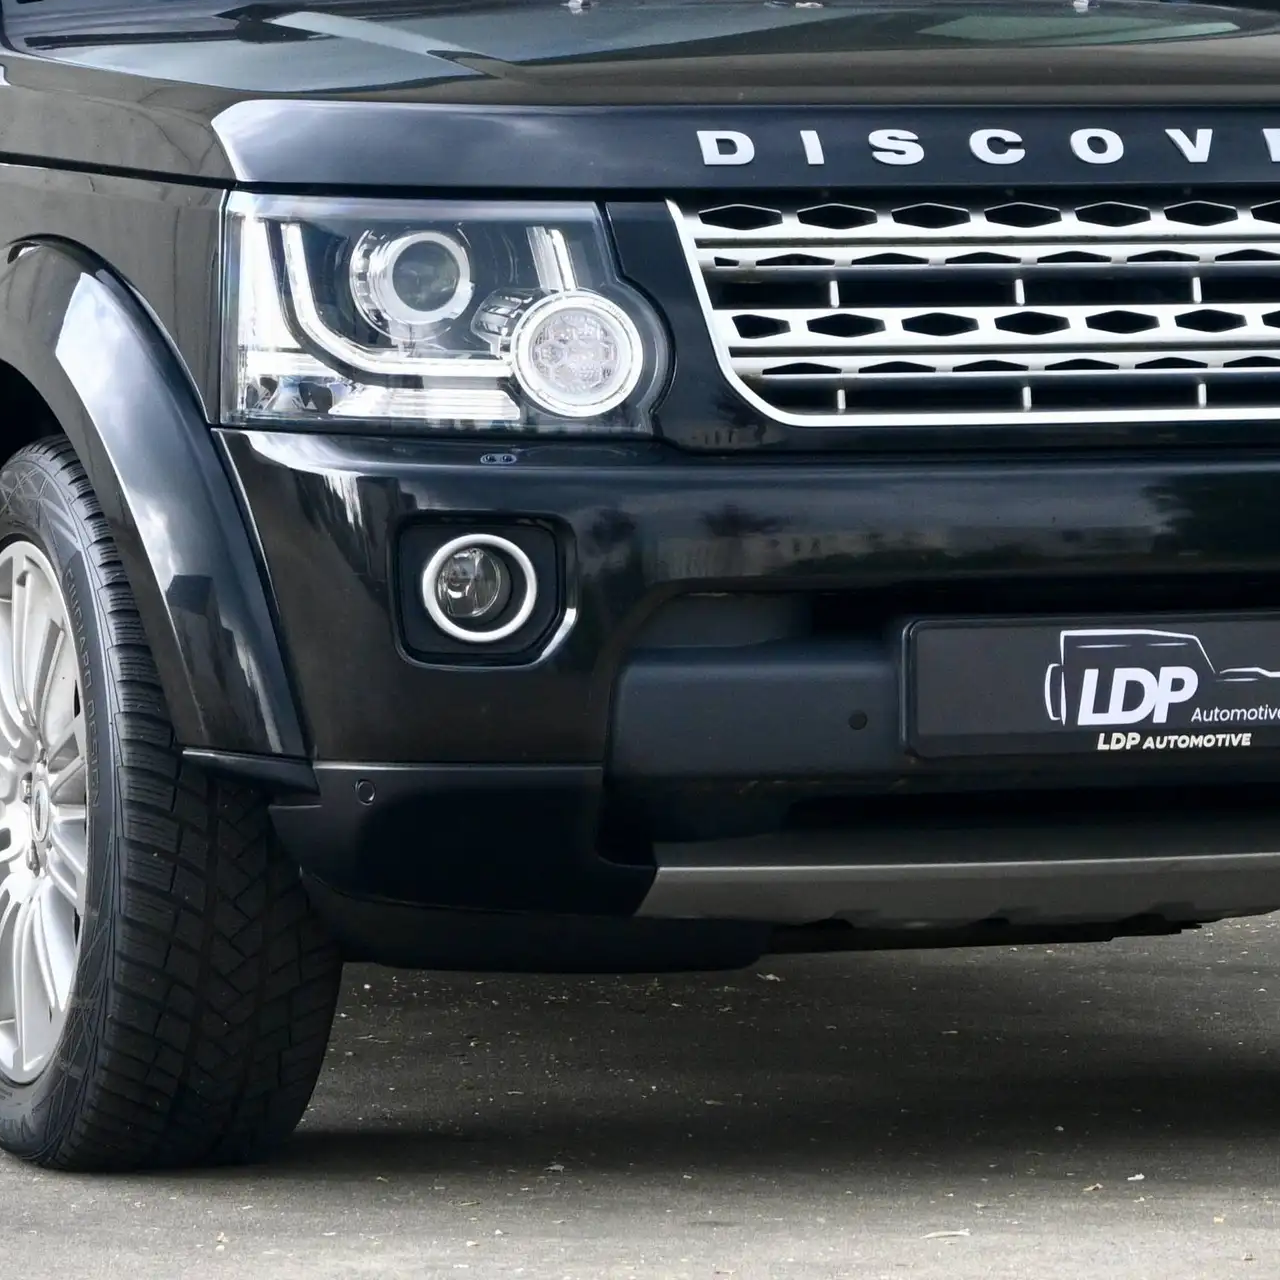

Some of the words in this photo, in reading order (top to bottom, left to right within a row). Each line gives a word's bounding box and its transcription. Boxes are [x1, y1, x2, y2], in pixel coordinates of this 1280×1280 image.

[1077, 666, 1199, 726] LDP
[1097, 732, 1141, 751] LDP
[1142, 732, 1252, 750] AUTOMOTIVE
